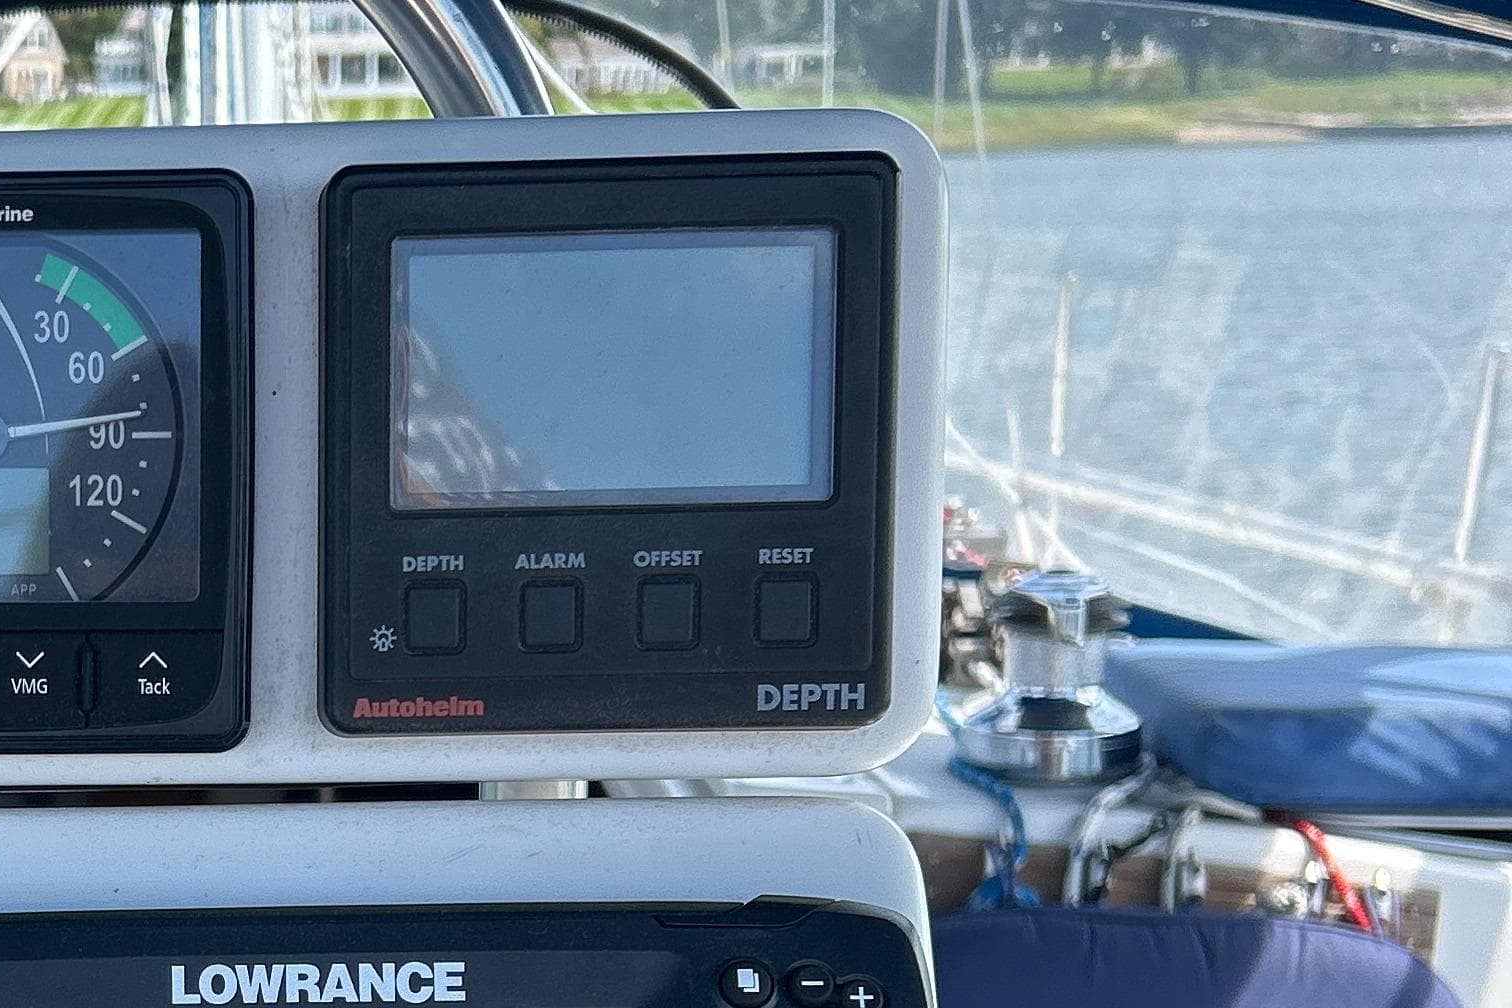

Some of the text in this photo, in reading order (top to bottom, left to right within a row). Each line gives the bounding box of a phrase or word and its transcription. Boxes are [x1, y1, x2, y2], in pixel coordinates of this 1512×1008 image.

[34, 310, 70, 344] 30
[68, 350, 104, 384] 60
[89, 418, 126, 450] 90
[69, 474, 123, 507] 120
[402, 554, 464, 572] DEPTH
[514, 552, 586, 570] ALARM
[633, 550, 703, 568] OFFSET
[758, 547, 814, 565] RESET
[10, 582, 37, 597] APP
[10, 677, 48, 694] VMG
[137, 677, 171, 695] Tack
[756, 683, 865, 712] DEPTH
[171, 961, 466, 1005] LOWRANCE
